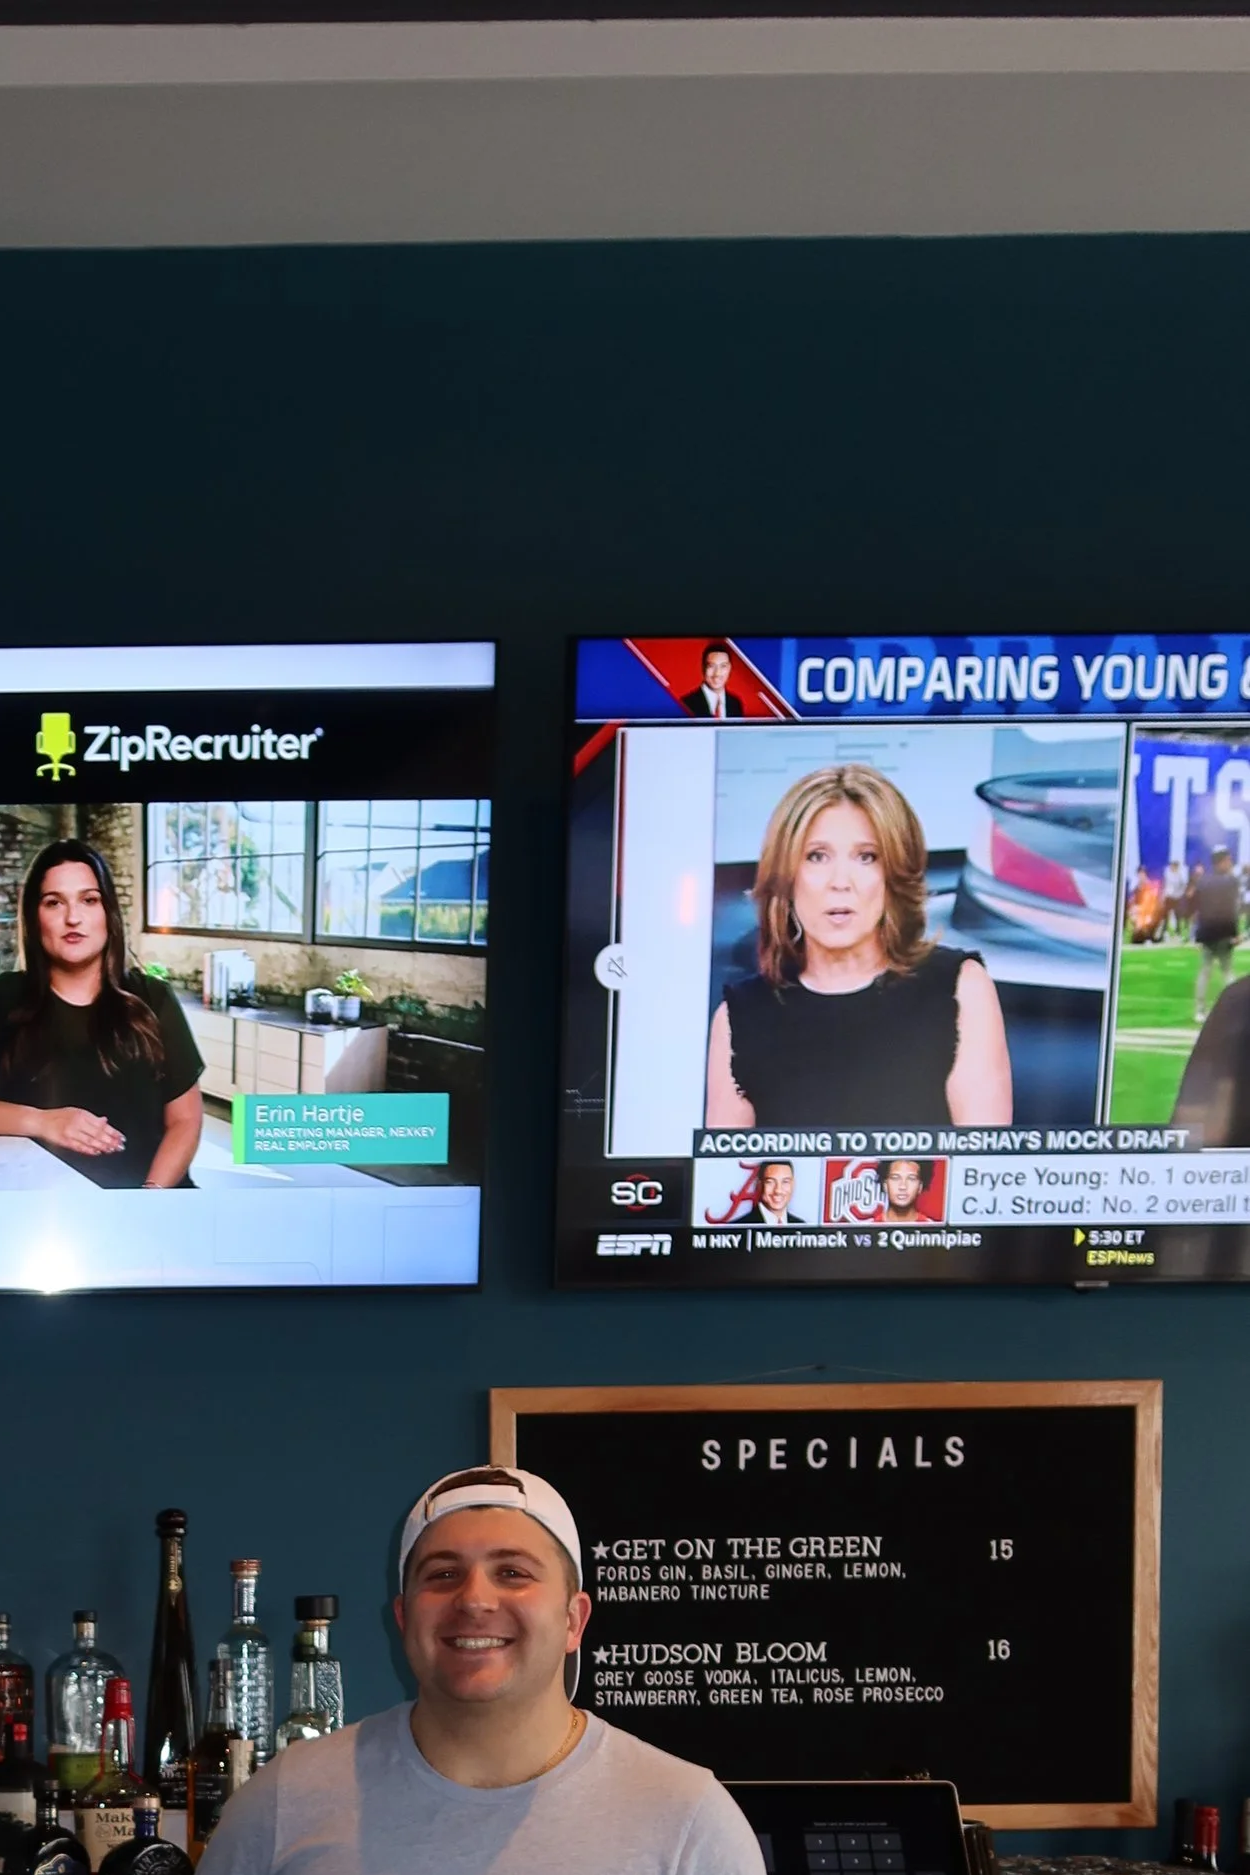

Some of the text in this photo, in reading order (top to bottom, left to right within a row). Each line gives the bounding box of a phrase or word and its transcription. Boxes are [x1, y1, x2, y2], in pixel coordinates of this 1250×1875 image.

[796, 655, 1060, 703] COMPARING
[1072, 653, 1229, 701] YOUNG
[83, 723, 323, 772] ZipRecruiter
[254, 1104, 366, 1125] Erin Hartje
[254, 1128, 324, 1138] MARKETING
[700, 1129, 1190, 1153] ACCORDING TO TODD McSHAY'S MOCK DRAFT
[254, 1140, 351, 1152] REAL EMPLOYER
[963, 1168, 1027, 1191] Bryce
[1033, 1167, 1109, 1191] Young:
[1119, 1167, 1156, 1186] No.
[1165, 1167, 1175, 1185] 1
[611, 1180, 664, 1207] SC
[962, 1196, 1003, 1216] C.J.
[1011, 1195, 1091, 1215] Stroud:
[1101, 1195, 1136, 1214] No.
[1145, 1194, 1159, 1213] 2
[1165, 1193, 1237, 1213] overall
[596, 1233, 673, 1256] ESPN
[692, 1229, 983, 1250] M HKY Merrimack vs 2 Quinnipiac
[1088, 1229, 1145, 1246] 5:30 ET
[1086, 1250, 1155, 1266] ESPNews
[700, 1436, 966, 1471] SPECIALS
[611, 1536, 1015, 1561] GET ON THE GREEN 15
[597, 1565, 652, 1582] FORDS
[597, 1584, 771, 1602] HABANERO TINCTURE
[610, 1638, 1012, 1665] HUDSON BLOOM 16
[594, 1672, 636, 1688] GREY
[643, 1671, 695, 1687] GOOSE
[709, 1688, 763, 1705] GREEN
[813, 1687, 854, 1704] ROSE
[862, 1686, 945, 1703] PROSECCO
